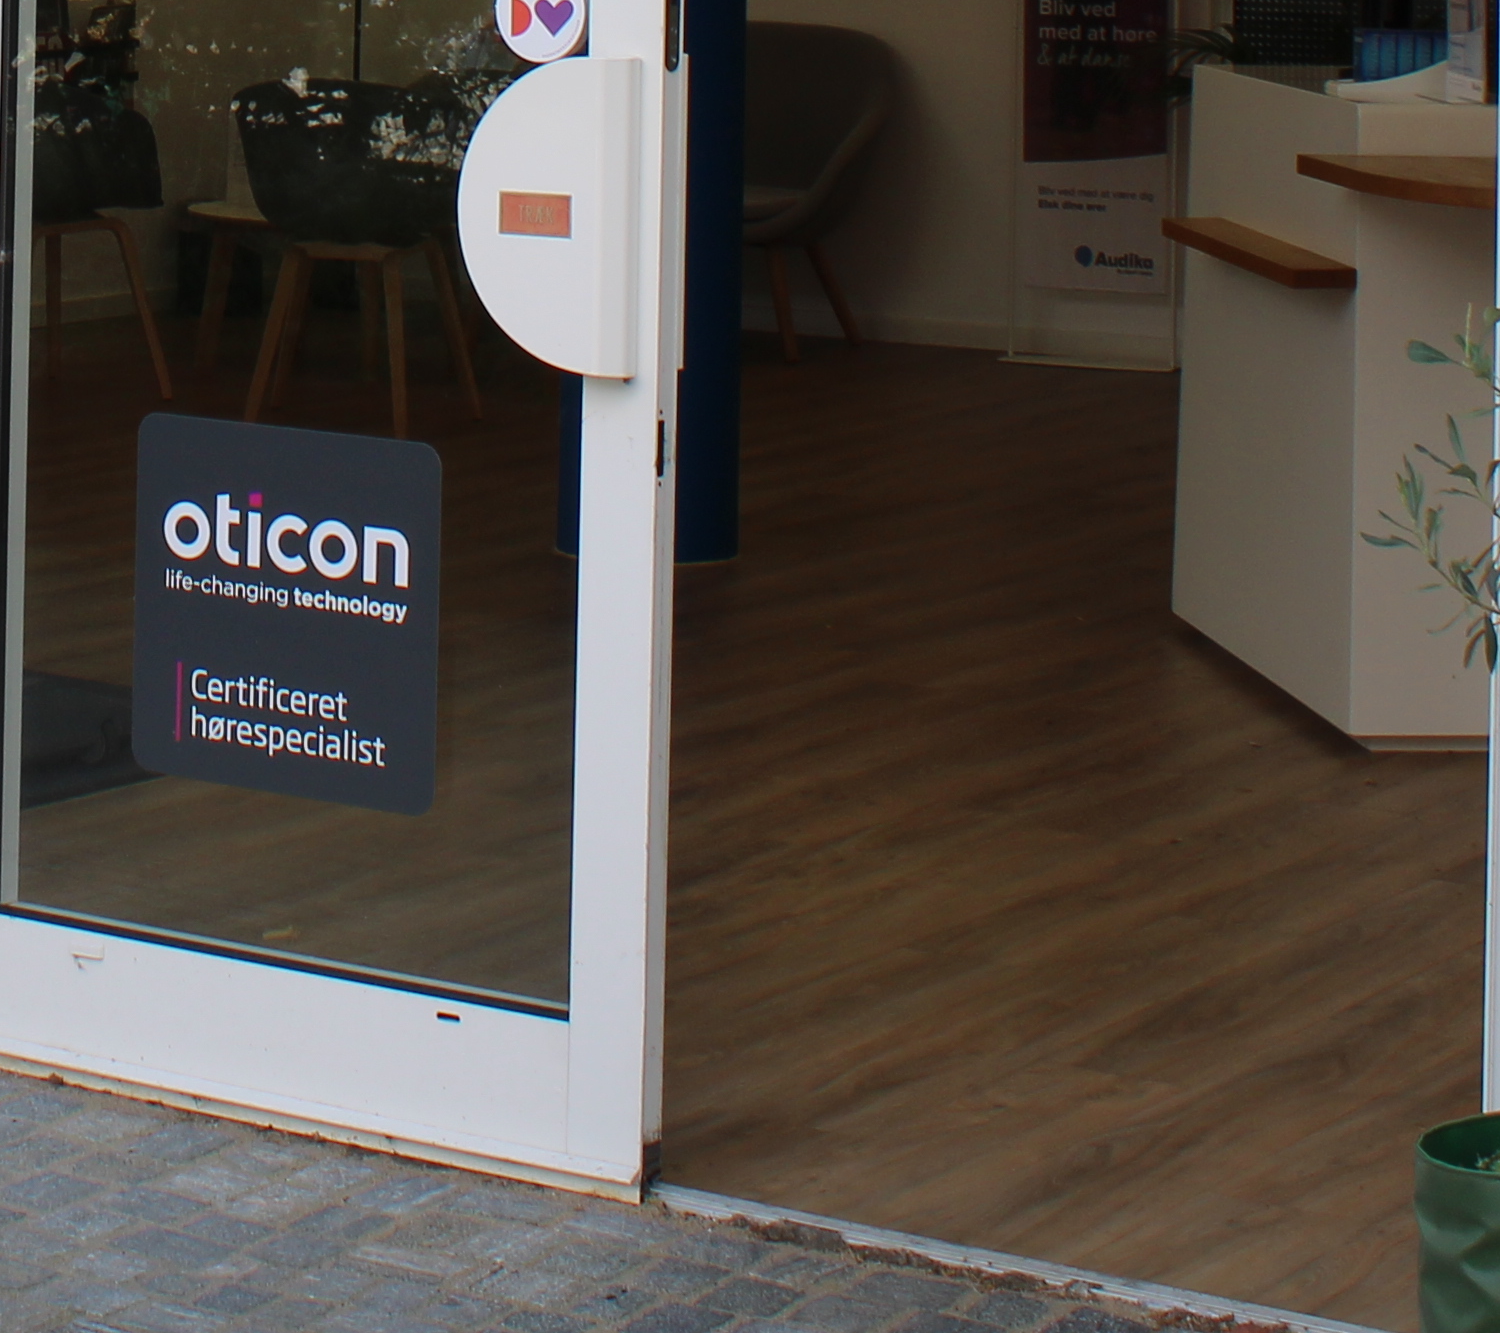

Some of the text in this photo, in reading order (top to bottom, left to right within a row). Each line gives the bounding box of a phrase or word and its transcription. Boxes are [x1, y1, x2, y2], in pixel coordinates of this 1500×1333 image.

[1081, 1, 1117, 18] ved
[1038, 24, 1085, 41] med
[1089, 25, 1107, 42] at
[518, 204, 555, 224] TRÆK
[1095, 250, 1155, 270] Audika
[163, 492, 410, 589] oticon
[164, 567, 408, 624] life-changing technology
[191, 668, 348, 722] Certificeret
[191, 704, 387, 767] hørespecialist
